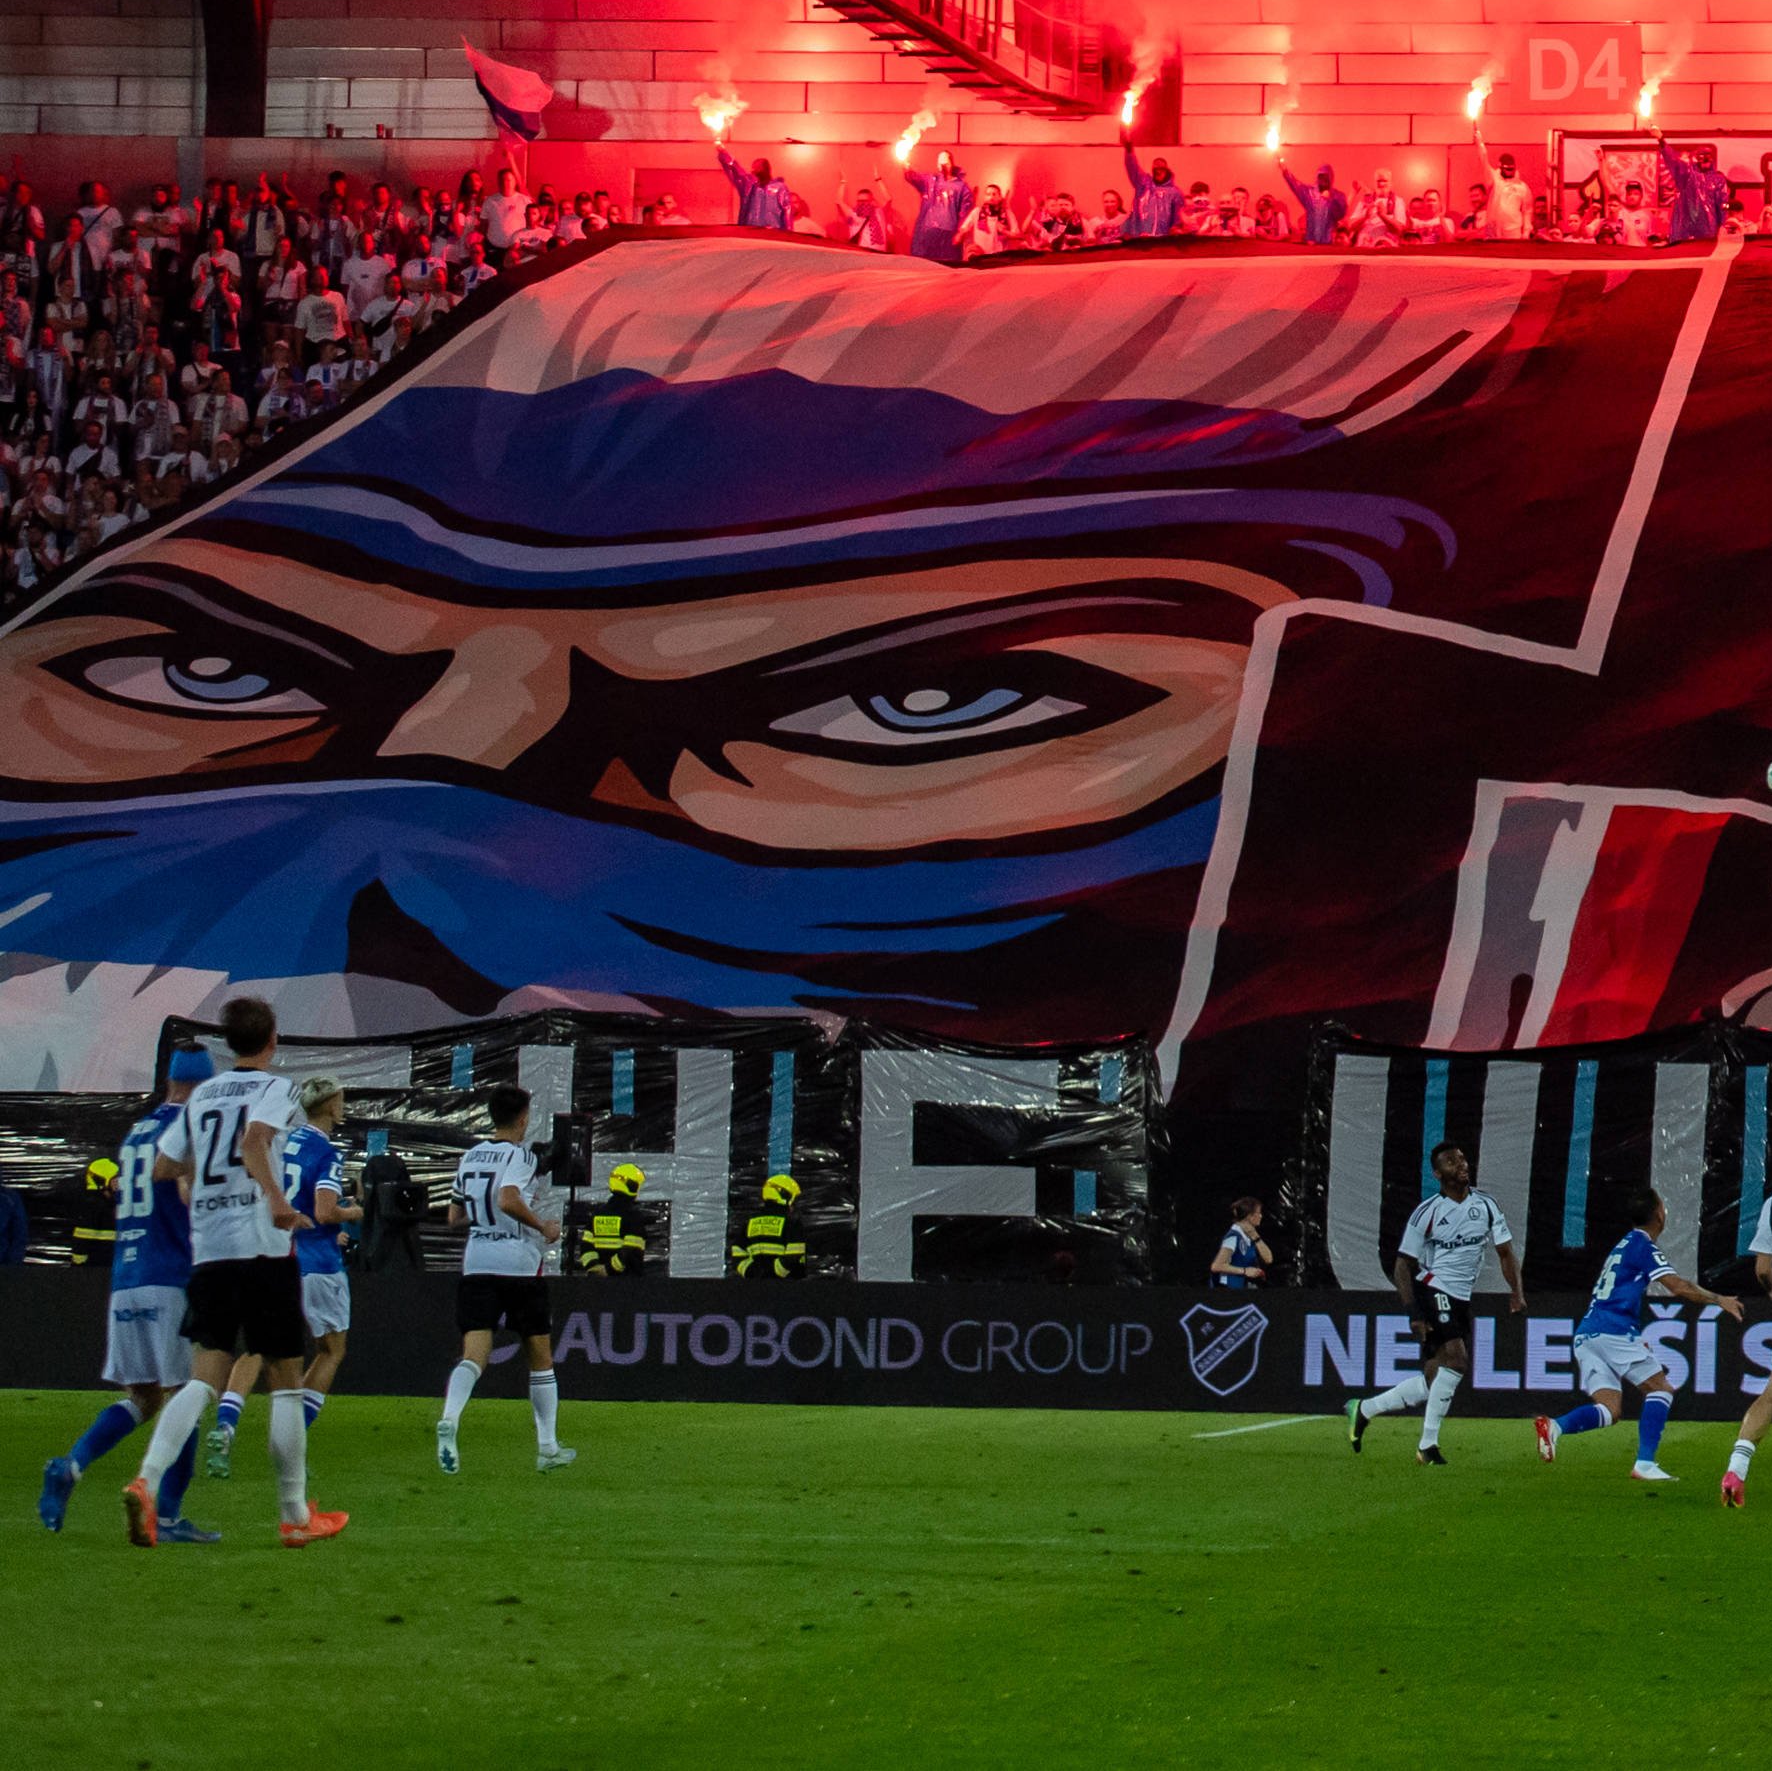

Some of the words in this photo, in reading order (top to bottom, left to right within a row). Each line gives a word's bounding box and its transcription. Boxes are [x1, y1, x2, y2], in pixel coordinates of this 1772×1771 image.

[1529, 38, 1627, 100] D4
[115, 1143, 155, 1219] 33
[462, 1171, 497, 1227] 67
[1434, 1292, 1452, 1311] 18
[553, 1311, 924, 1369] AUTOBOND
[941, 1319, 1154, 1374] GROUP
[1304, 1303, 1724, 1394] NELEŠÍ
